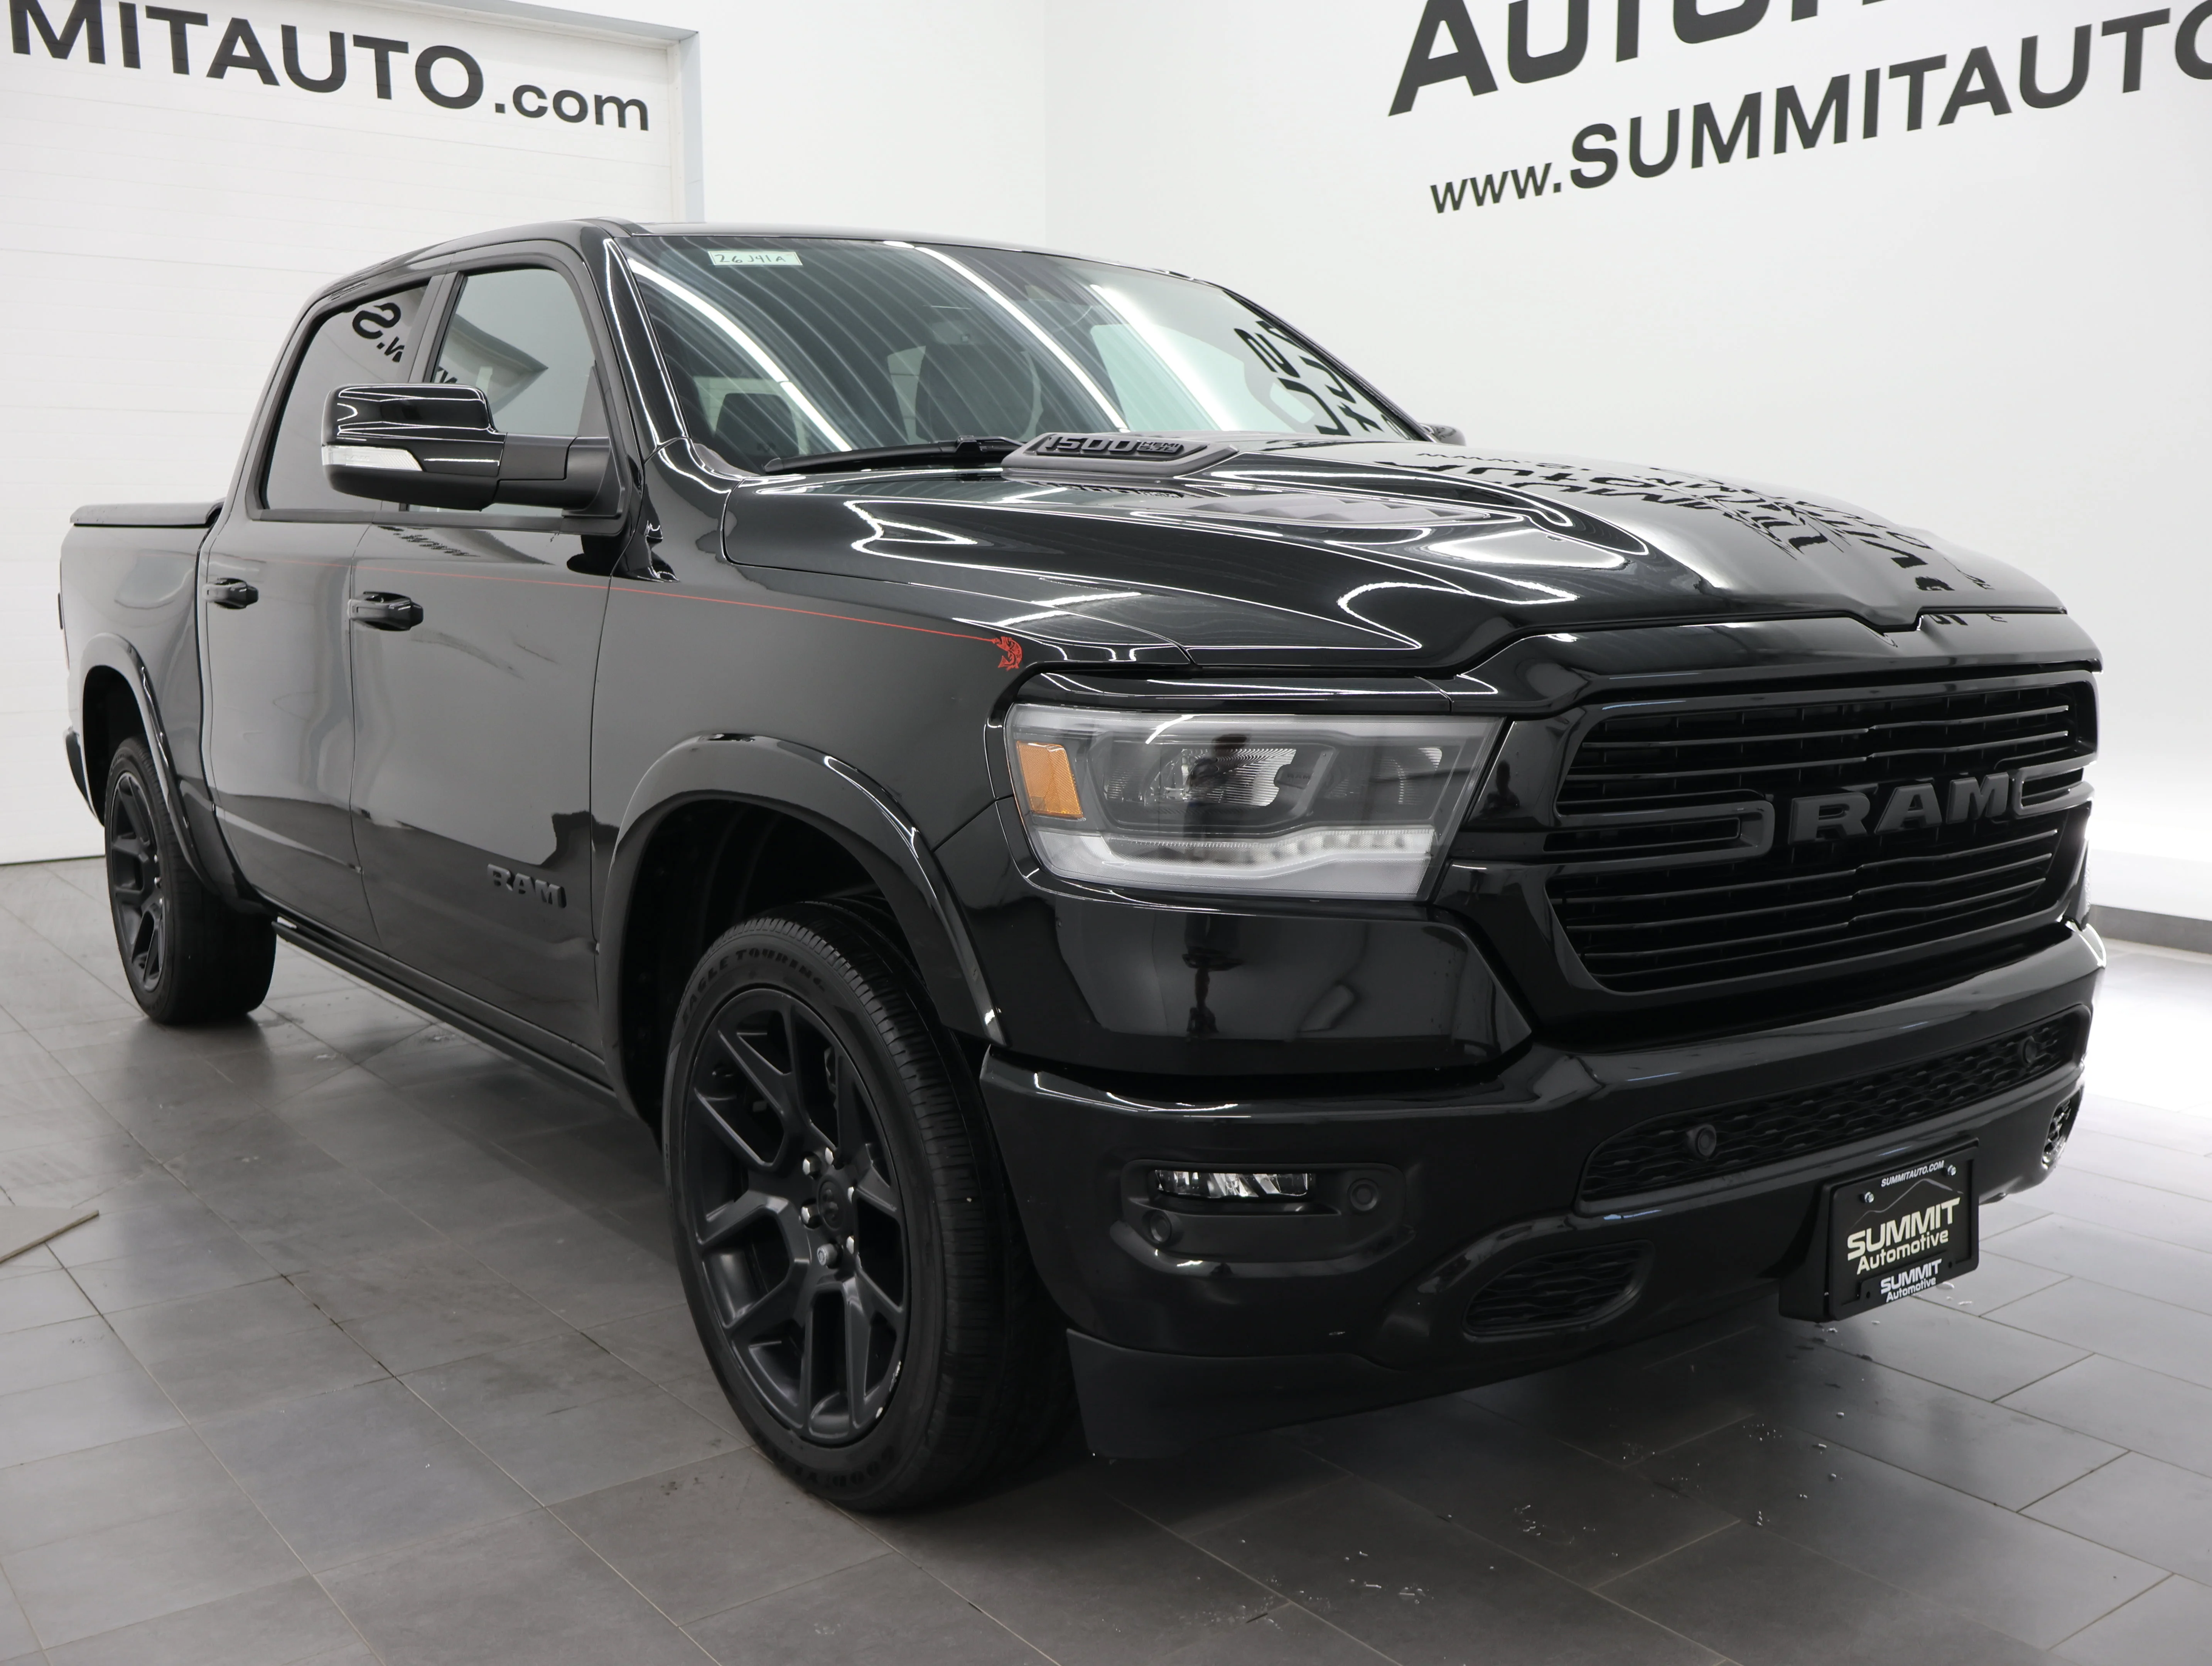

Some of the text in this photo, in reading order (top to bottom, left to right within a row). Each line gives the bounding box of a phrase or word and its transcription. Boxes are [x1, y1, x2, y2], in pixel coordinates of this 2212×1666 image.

[1045, 436, 1141, 452] 1500
[1788, 772, 2009, 845] RAM
[487, 863, 567, 908] RAM
[682, 948, 826, 1025] EAGLE TOURING
[1881, 1160, 1944, 1187] SUMMITAUTO.COM
[1847, 1197, 1961, 1261] SUMMIT
[1856, 1229, 1949, 1275] Automotive
[1881, 1258, 1942, 1294] SUMMIT
[1886, 1277, 1936, 1303] Automotive
